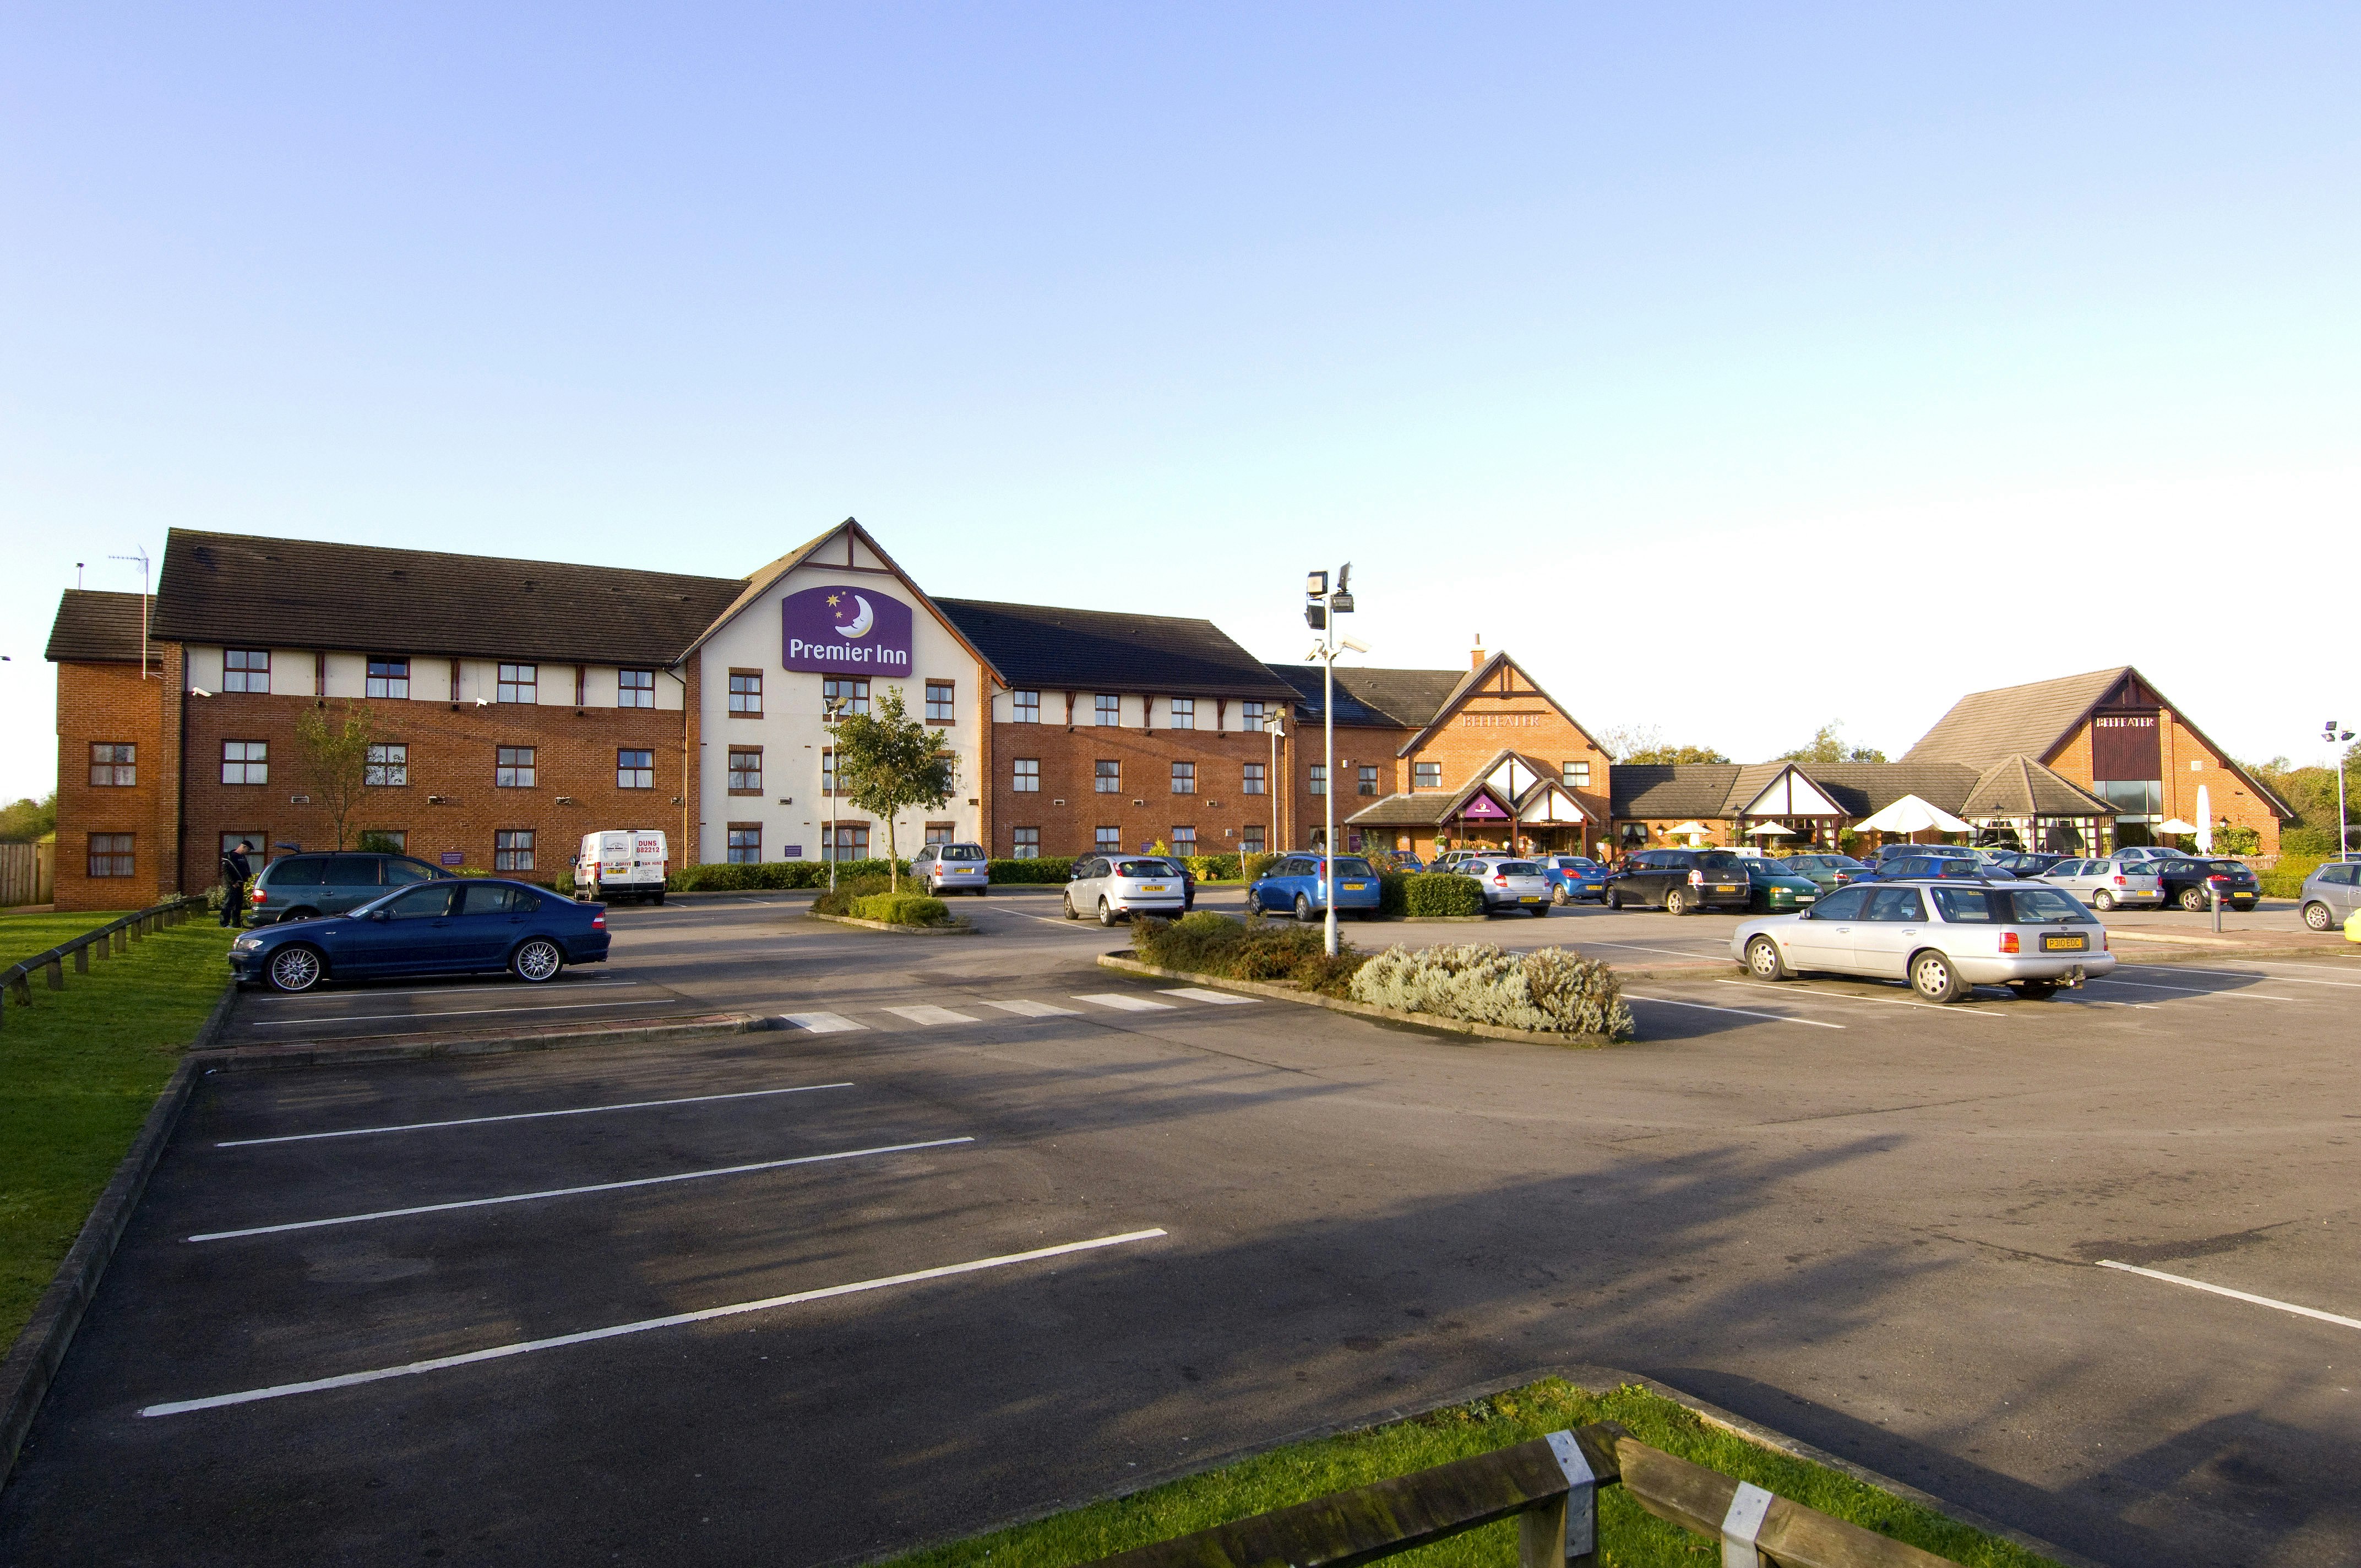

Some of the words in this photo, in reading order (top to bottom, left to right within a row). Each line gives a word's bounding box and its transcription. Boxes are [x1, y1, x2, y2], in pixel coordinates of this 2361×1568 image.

[790, 639, 873, 662] Premier
[877, 644, 907, 665] Inn
[1462, 715, 1541, 727] BEEFEATER
[2096, 717, 2154, 727] BEEFEATER
[2049, 939, 2065, 947] P310
